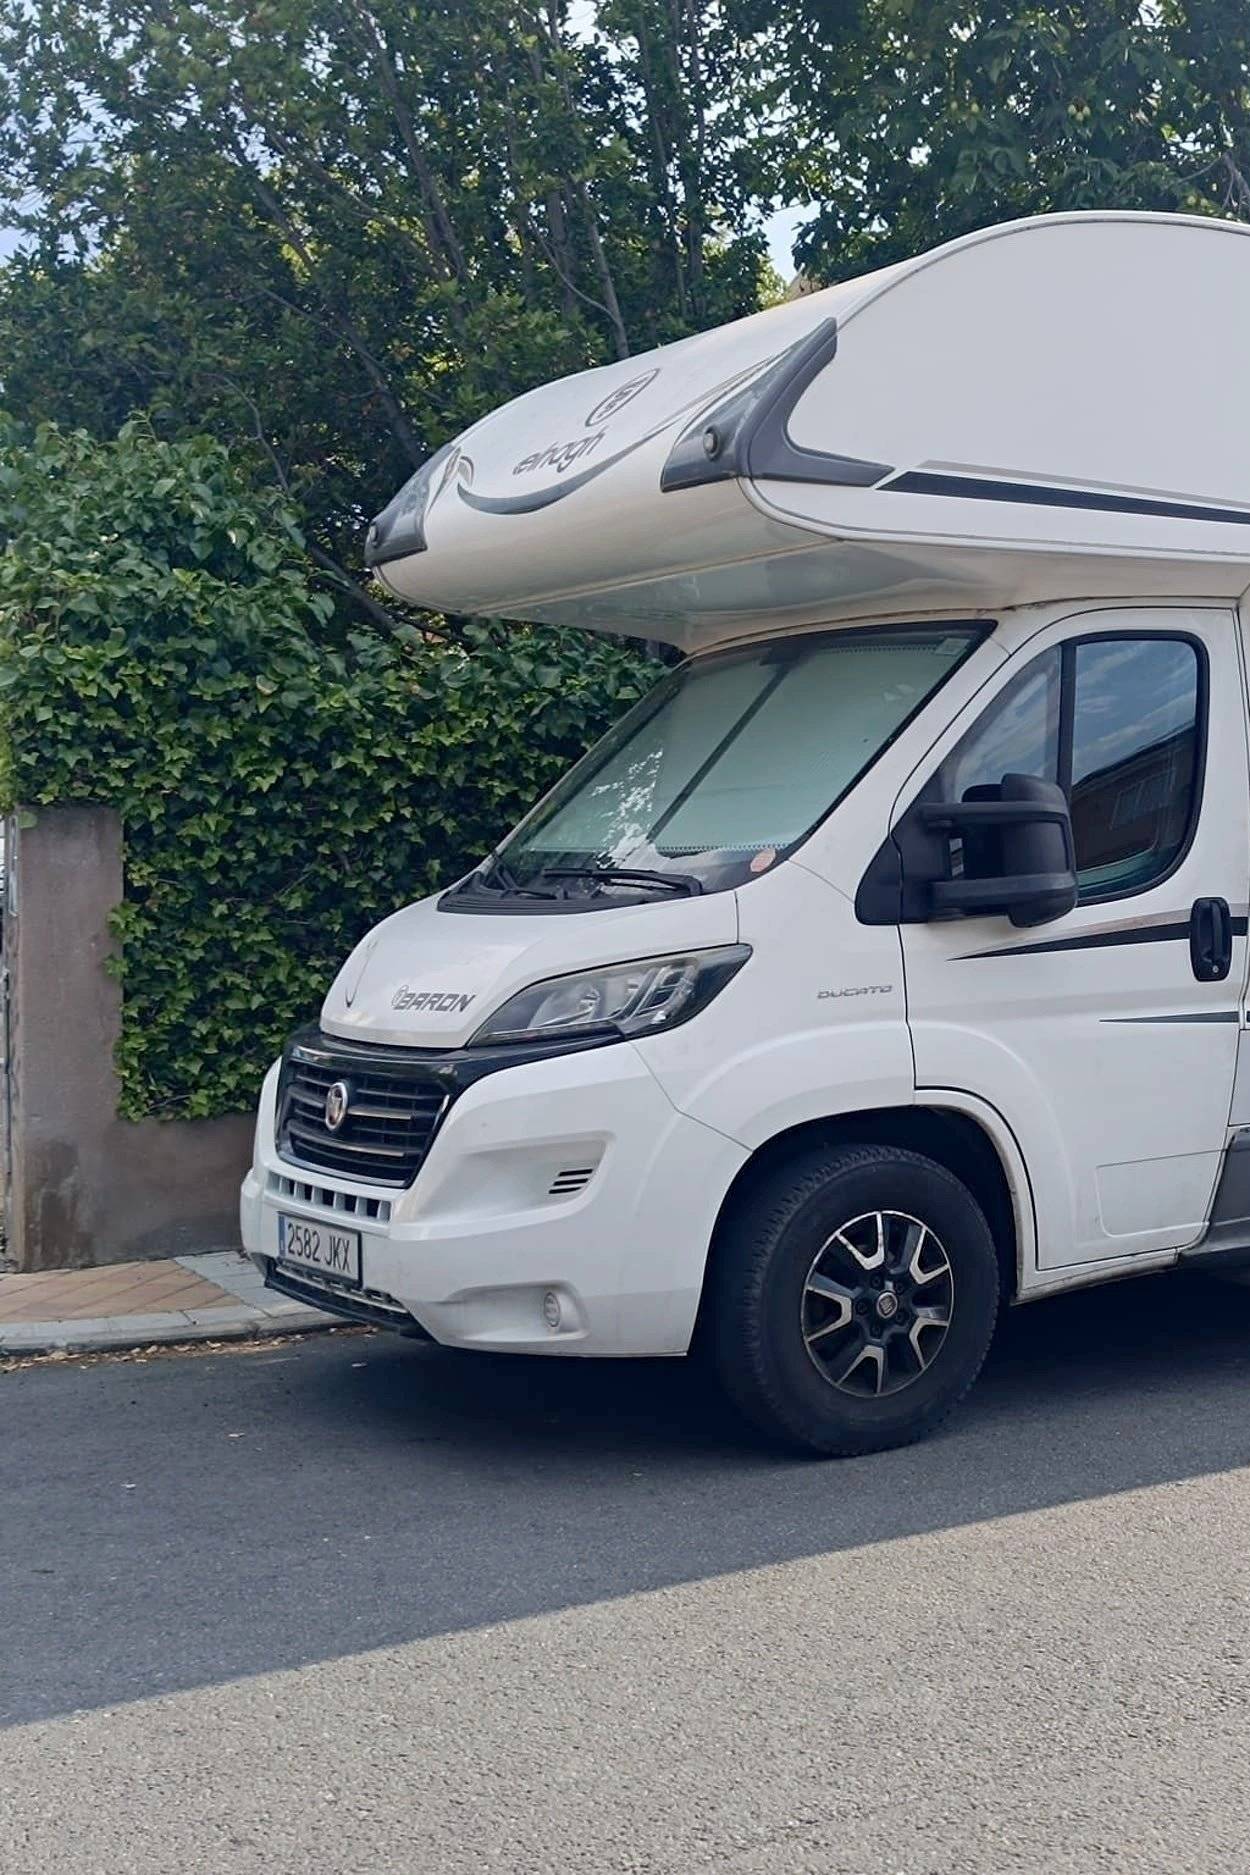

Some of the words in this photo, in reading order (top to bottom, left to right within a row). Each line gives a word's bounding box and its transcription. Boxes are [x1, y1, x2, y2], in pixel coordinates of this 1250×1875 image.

[393, 992, 477, 1012] BARON
[817, 985, 892, 1000] DUCATO
[287, 1222, 321, 1262] 2582
[325, 1234, 352, 1274] JKX
